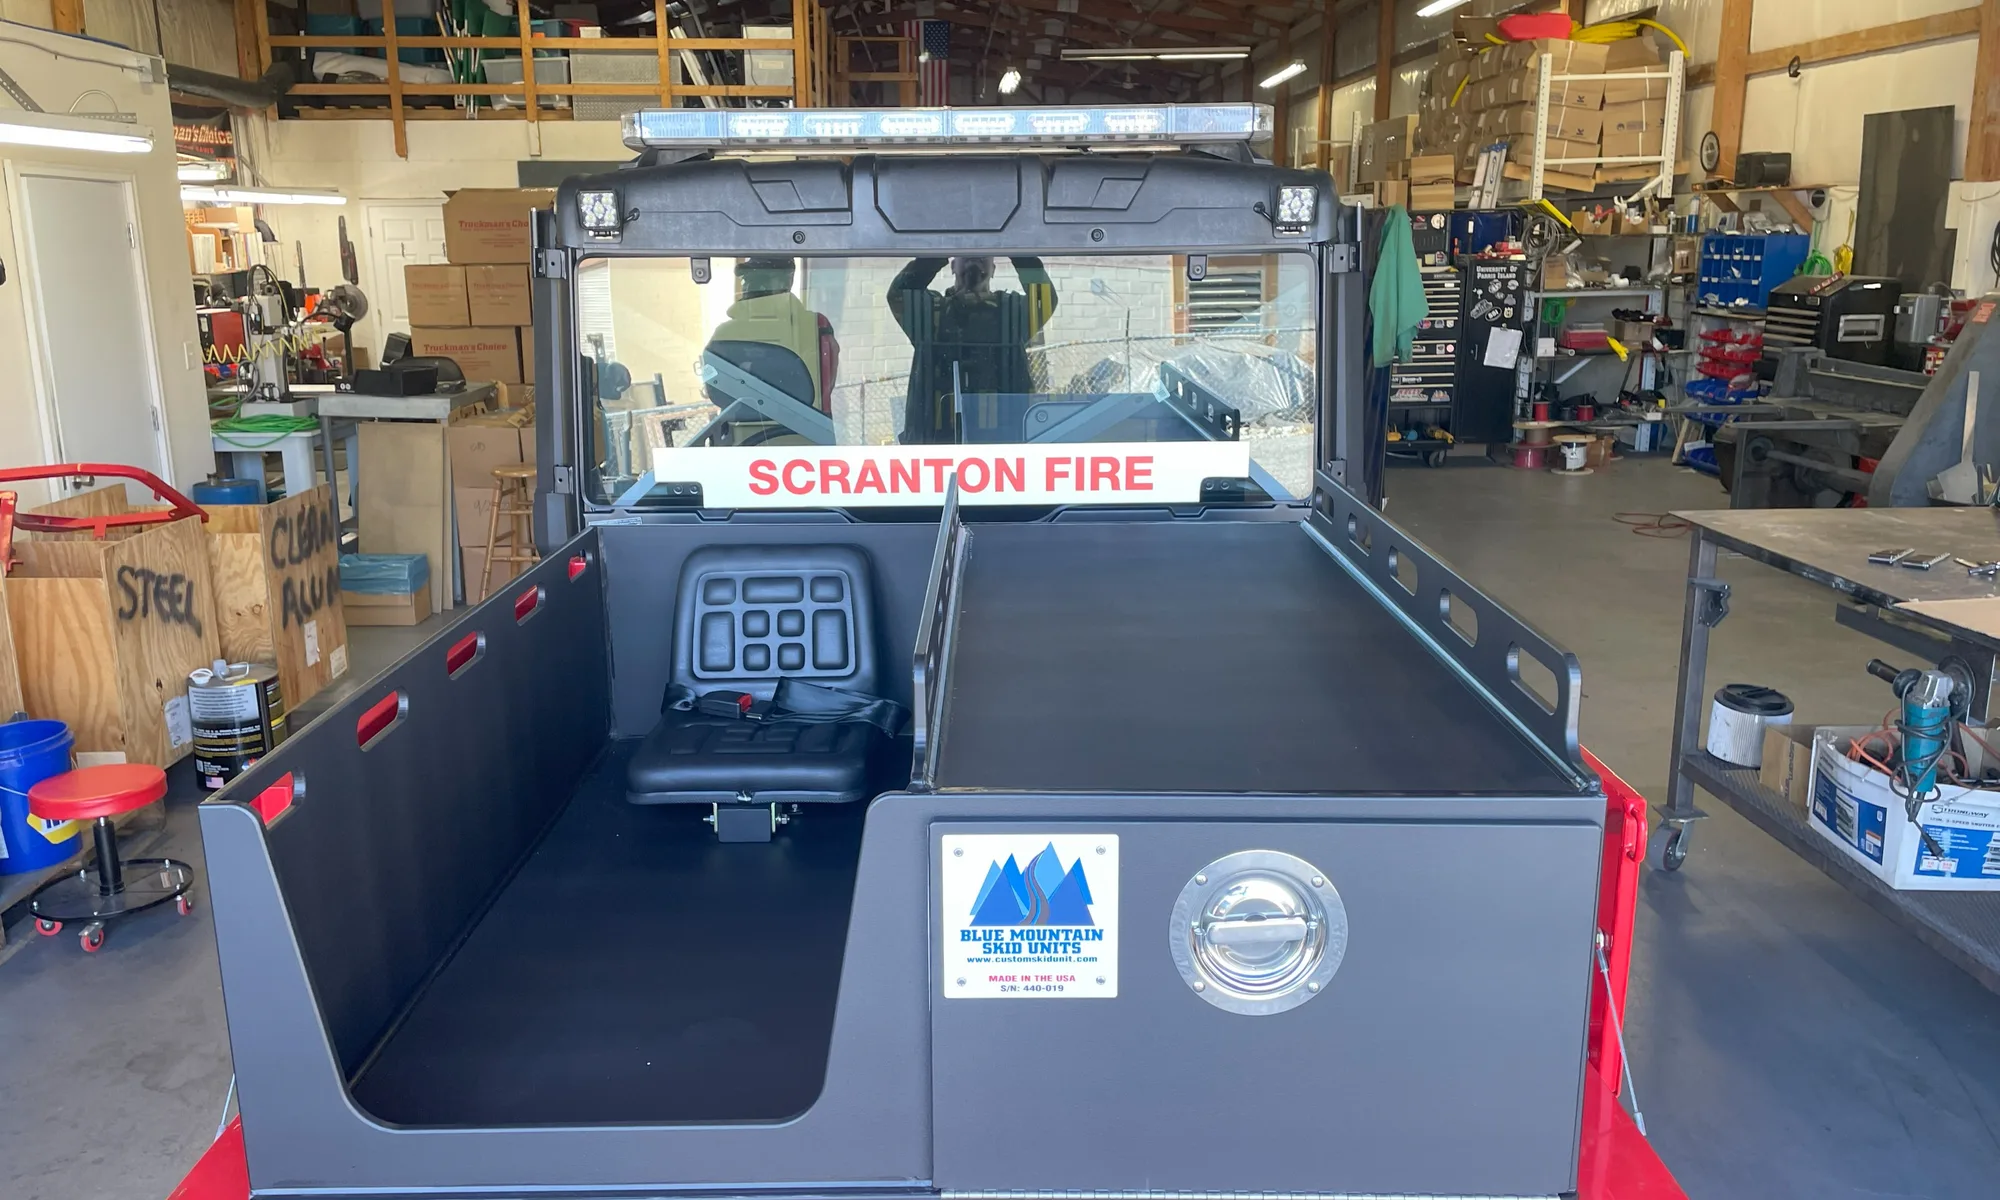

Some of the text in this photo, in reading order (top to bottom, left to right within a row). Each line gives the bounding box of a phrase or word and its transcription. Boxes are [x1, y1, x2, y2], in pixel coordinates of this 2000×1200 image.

[200, 124, 233, 144] Choice
[458, 220, 529, 228] Truckman's Cho
[423, 343, 507, 352] Truckman's Choice
[749, 456, 1154, 495] SCRANTON FIRE
[117, 565, 202, 638] STEEL
[960, 929, 1104, 942] BLUE MOUNTAIN
[983, 942, 1081, 954] SKID UNITS
